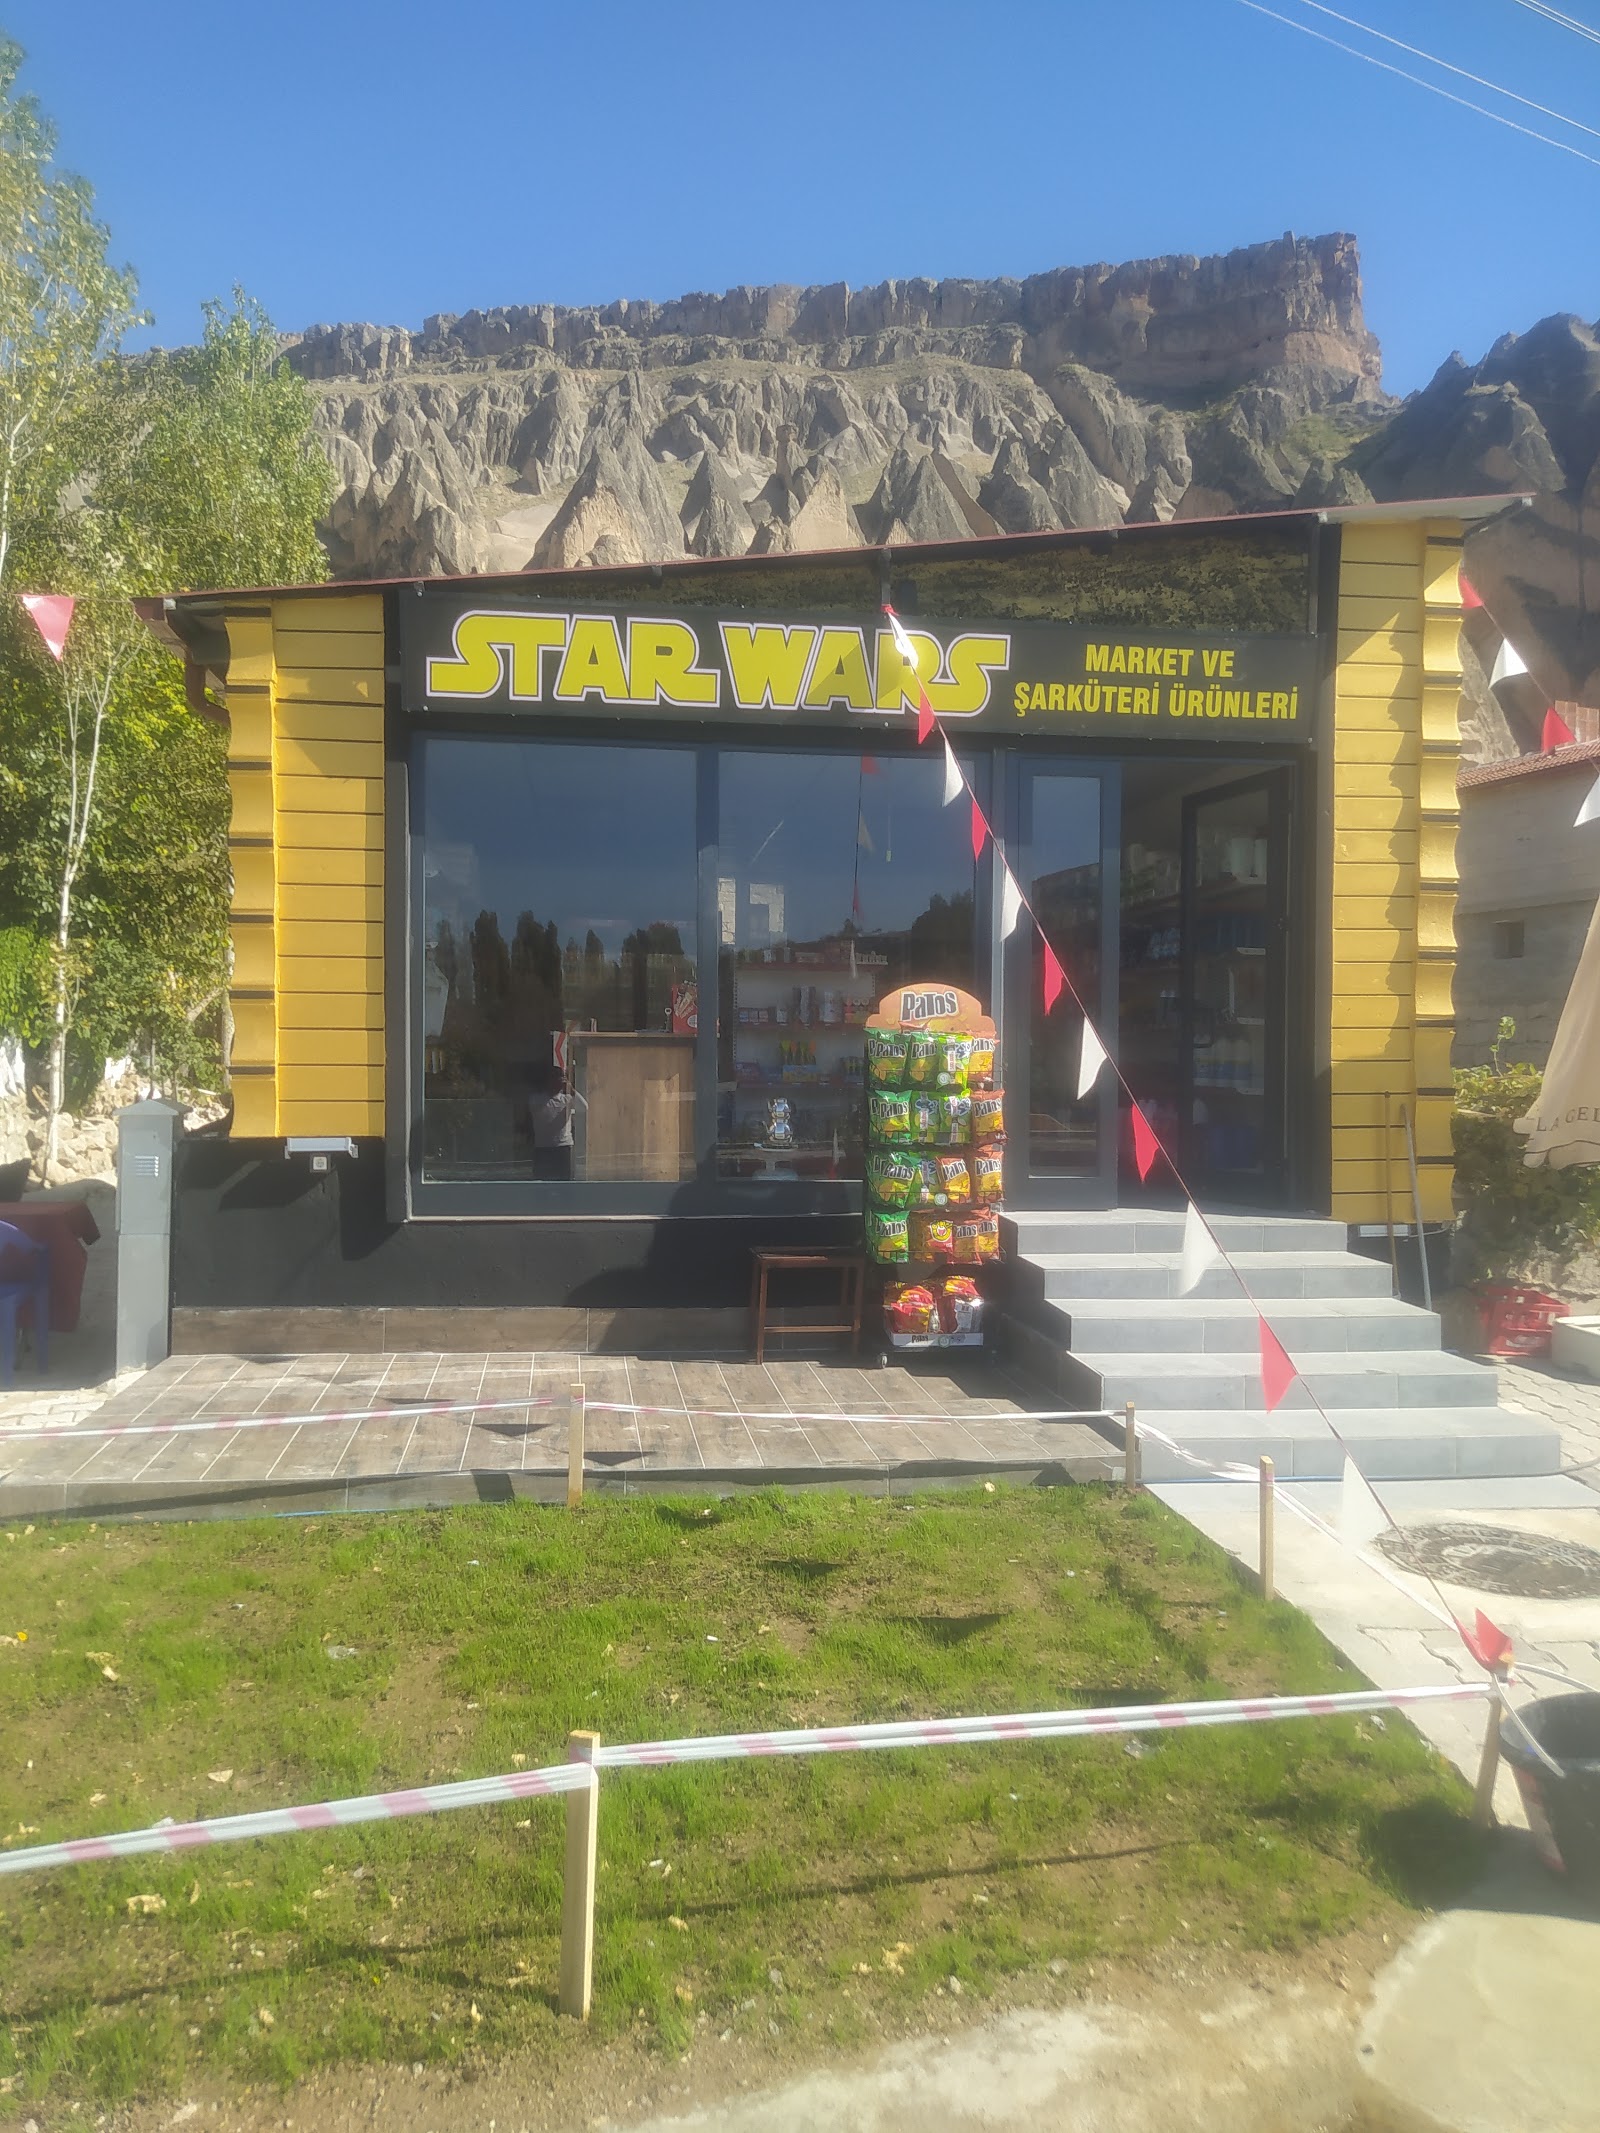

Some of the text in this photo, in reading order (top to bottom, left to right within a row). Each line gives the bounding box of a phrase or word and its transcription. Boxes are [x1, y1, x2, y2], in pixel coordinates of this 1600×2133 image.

[426, 610, 1011, 717] STAR WARS
[1085, 643, 1235, 678] MARKET VE
[1013, 678, 1298, 720] ŞARKÜTERİ ÜRÜNLERİ
